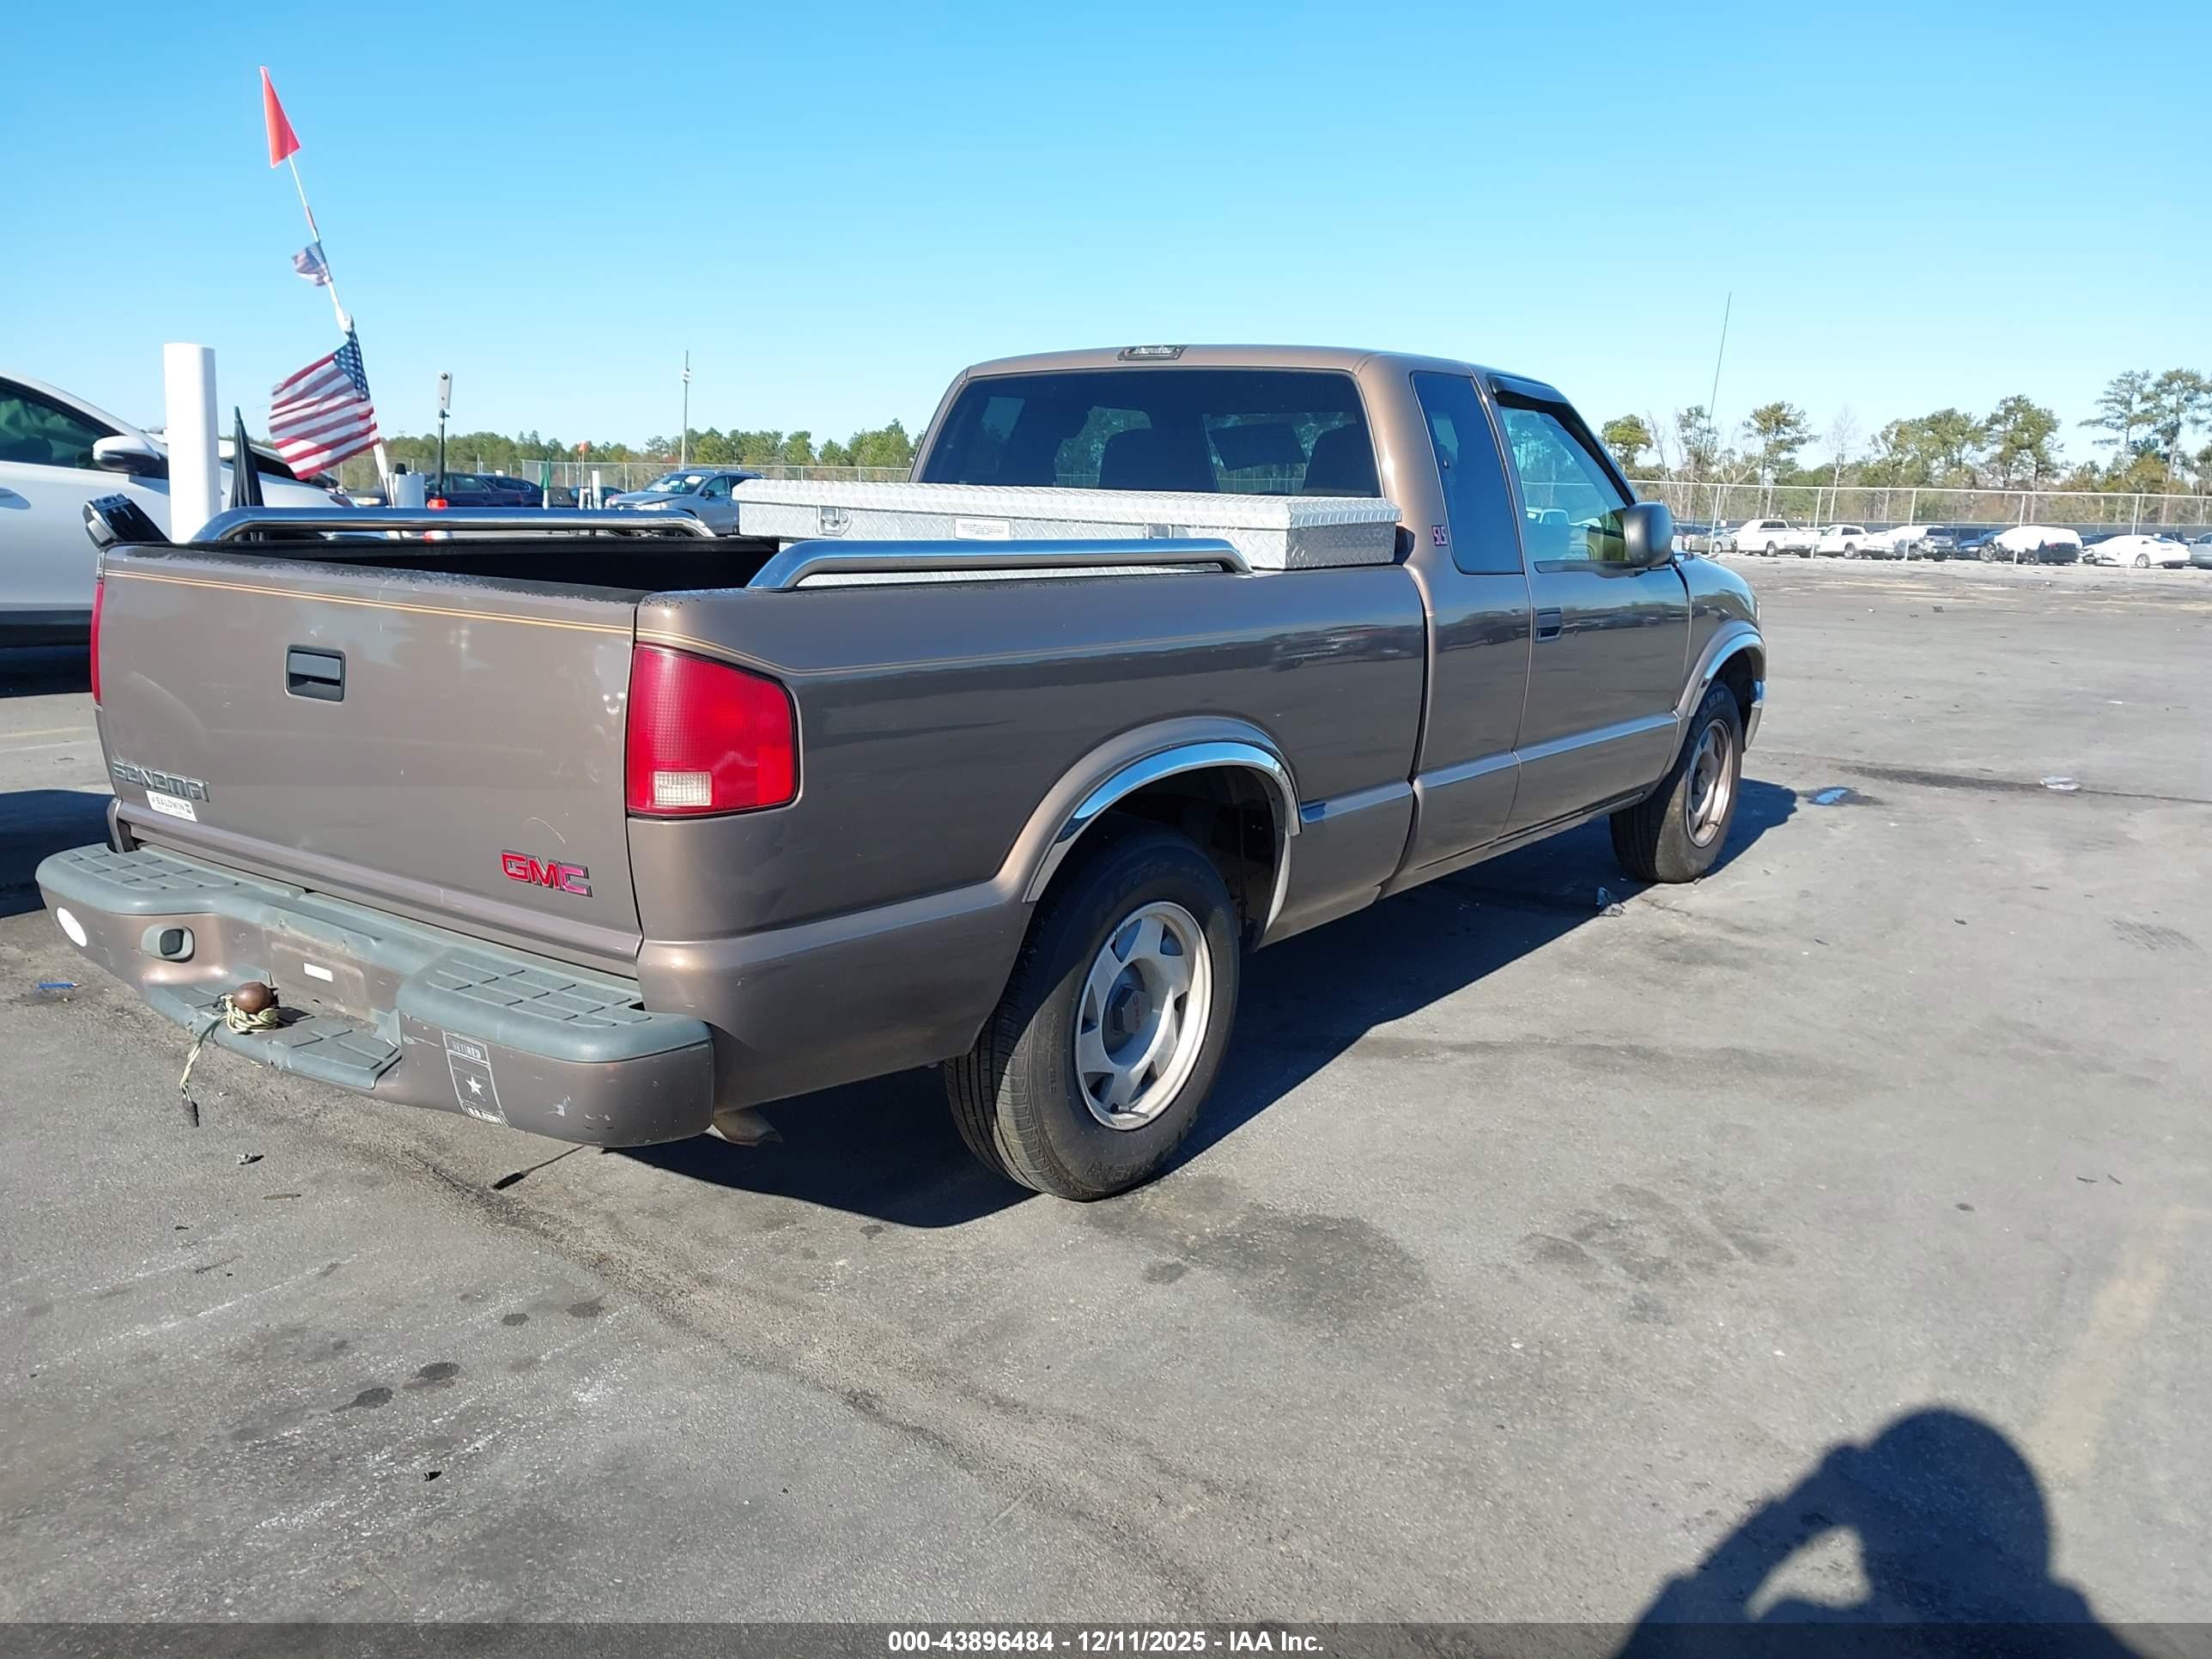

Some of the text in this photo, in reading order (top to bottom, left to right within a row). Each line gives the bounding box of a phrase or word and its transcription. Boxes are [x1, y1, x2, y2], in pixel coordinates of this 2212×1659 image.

[1431, 525, 1448, 546] SLS
[112, 760, 210, 803] SONOMA
[501, 849, 592, 897] GMC
[452, 1041, 481, 1060] RETIRED
